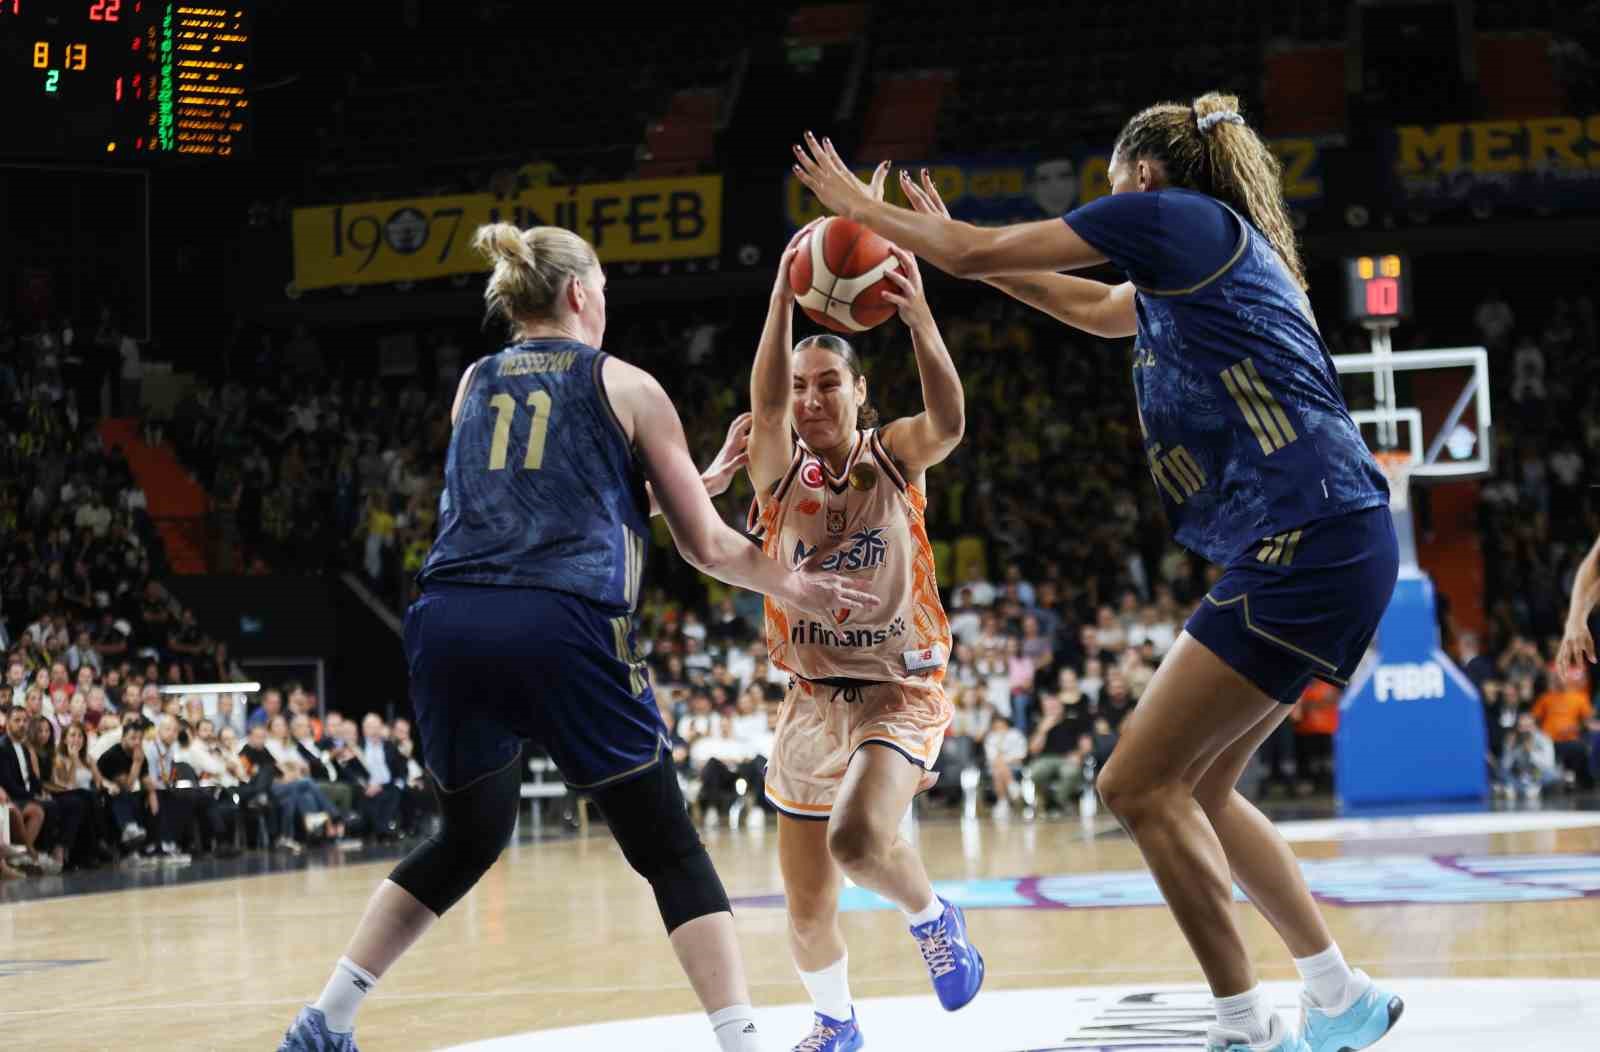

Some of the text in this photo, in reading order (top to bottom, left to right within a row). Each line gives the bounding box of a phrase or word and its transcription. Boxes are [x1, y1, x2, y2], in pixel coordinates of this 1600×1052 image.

[89, 0, 121, 22] 22
[33, 41, 87, 70] 8 13
[45, 69, 60, 92] 2
[115, 76, 123, 101] 1
[1396, 117, 1600, 174] MER
[1366, 277, 1398, 315] 10
[488, 390, 552, 471] 11
[1374, 662, 1445, 702] FIBA
